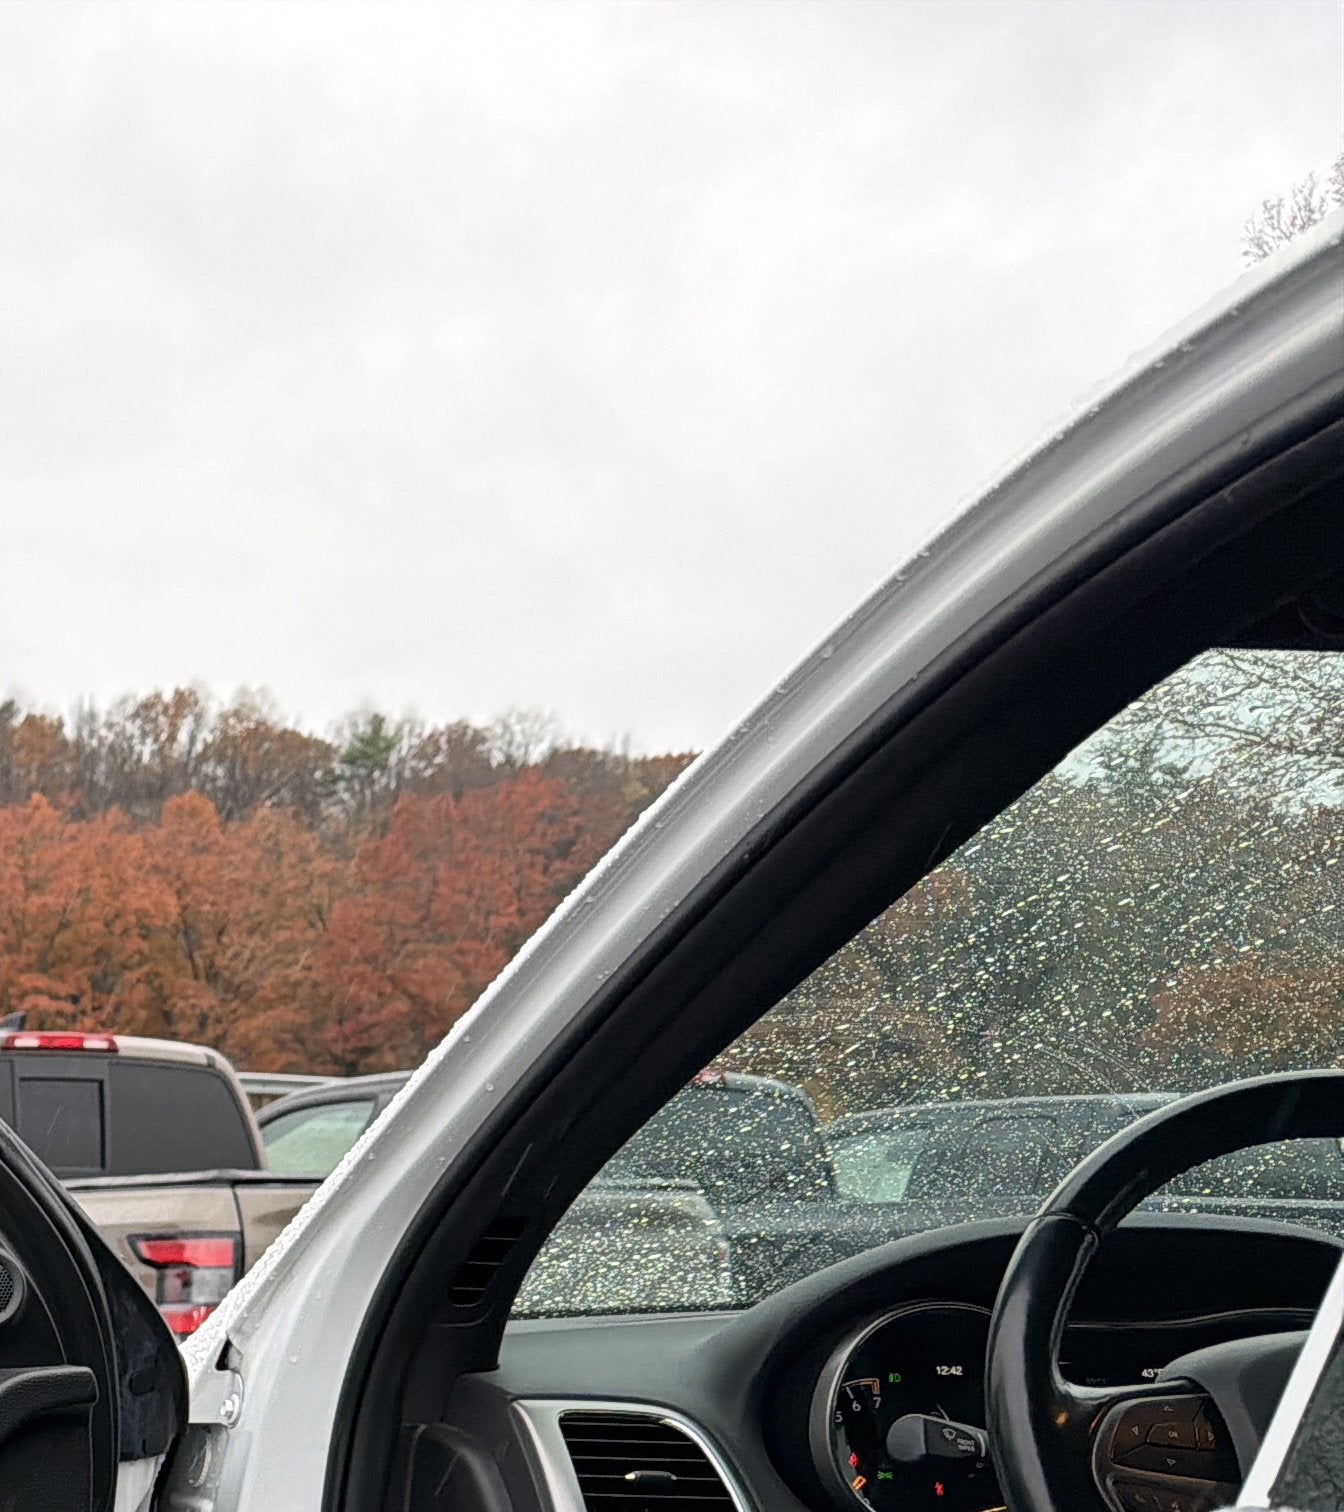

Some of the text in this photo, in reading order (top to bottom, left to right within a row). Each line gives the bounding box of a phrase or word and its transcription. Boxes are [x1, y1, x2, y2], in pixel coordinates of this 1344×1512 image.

[935, 1365, 964, 1377] 12:42
[852, 1401, 862, 1412] 6
[873, 1397, 882, 1409] 7
[834, 1411, 843, 1423] 5
